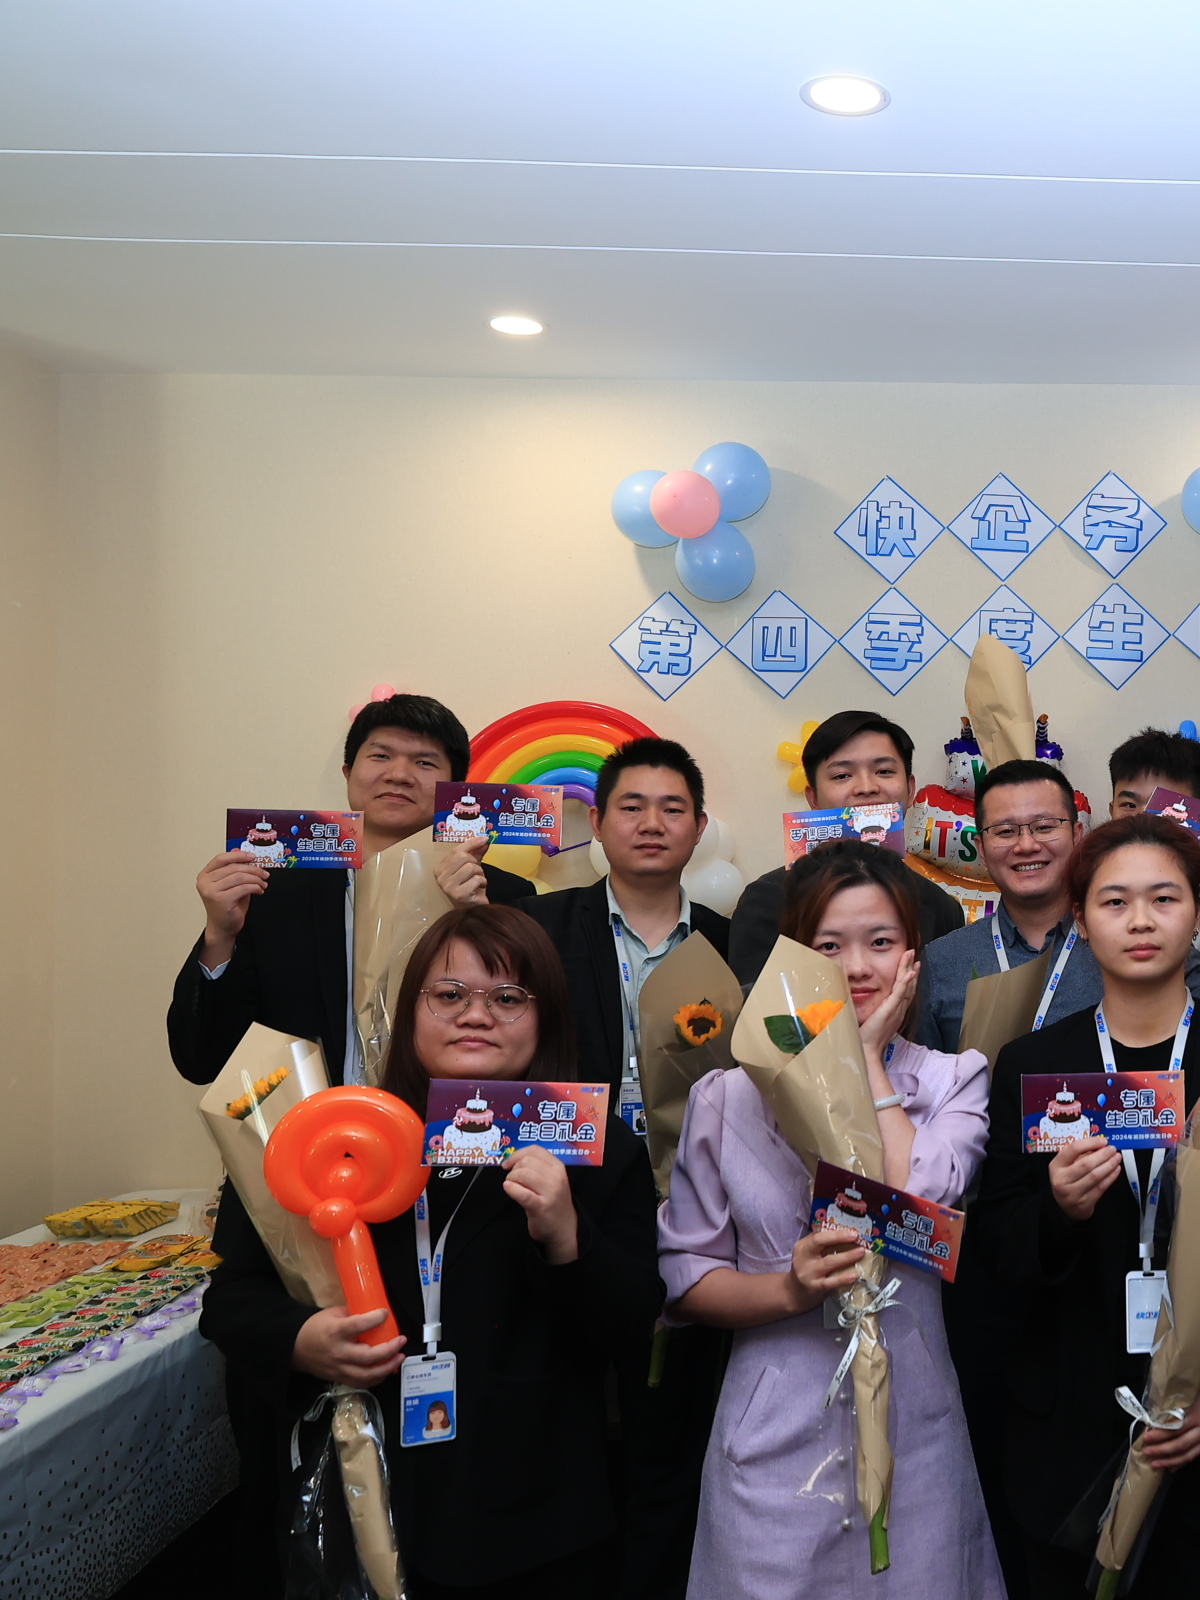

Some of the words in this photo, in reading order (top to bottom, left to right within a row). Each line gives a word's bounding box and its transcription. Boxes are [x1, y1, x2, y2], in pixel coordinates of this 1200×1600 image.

[858, 493, 1144, 558] 快企务
[512, 797, 541, 812] 专属
[498, 813, 555, 828] 生日礼金
[310, 823, 340, 838] 专属
[790, 824, 843, 842] 生日礼金
[923, 817, 979, 862] IT'S
[296, 838, 357, 852] 生日礼金
[1120, 1089, 1156, 1108] 专属
[537, 1100, 577, 1121] 专属
[1105, 1108, 1176, 1129] 生日礼金
[518, 1121, 596, 1141] 生日礼金
[437, 1156, 503, 1164] BIRTHDAY
[438, 1148, 482, 1156] HAPPY
[901, 1209, 935, 1236] 专属
[885, 1221, 950, 1260] 生日礼金
